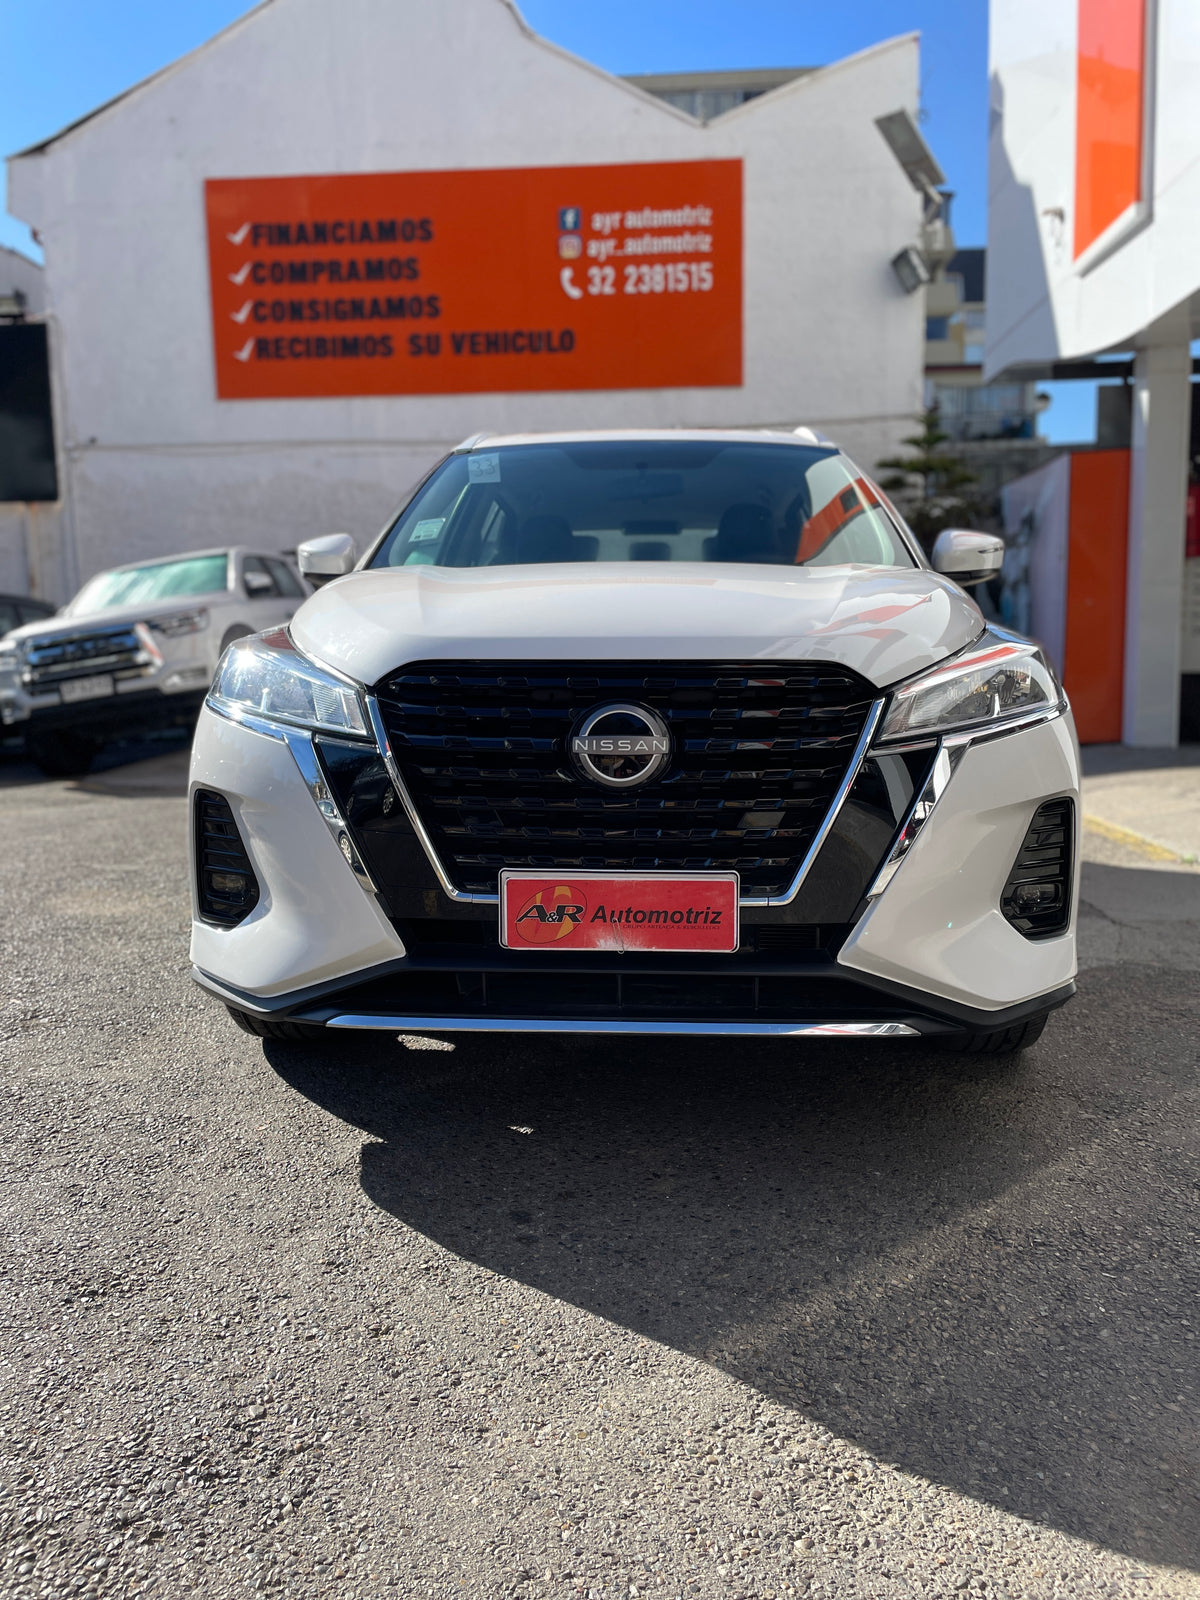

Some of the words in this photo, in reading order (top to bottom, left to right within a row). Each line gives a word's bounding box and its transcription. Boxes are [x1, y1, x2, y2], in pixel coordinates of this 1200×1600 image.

[252, 218, 433, 247] FINANCIAMOS
[592, 212, 622, 235] ayr
[624, 205, 713, 229] automotriz
[252, 257, 419, 284] COMPRAMOS
[587, 265, 616, 295] 32
[624, 262, 714, 294] 2381515
[253, 295, 441, 322] CONSIGNAMOS
[256, 335, 393, 360] RECIBIMOS
[409, 333, 441, 356] SU
[451, 329, 575, 355] VEHICULO
[574, 739, 667, 751] NISSAN
[515, 904, 582, 923] A&R
[590, 905, 723, 925] Automotriz
